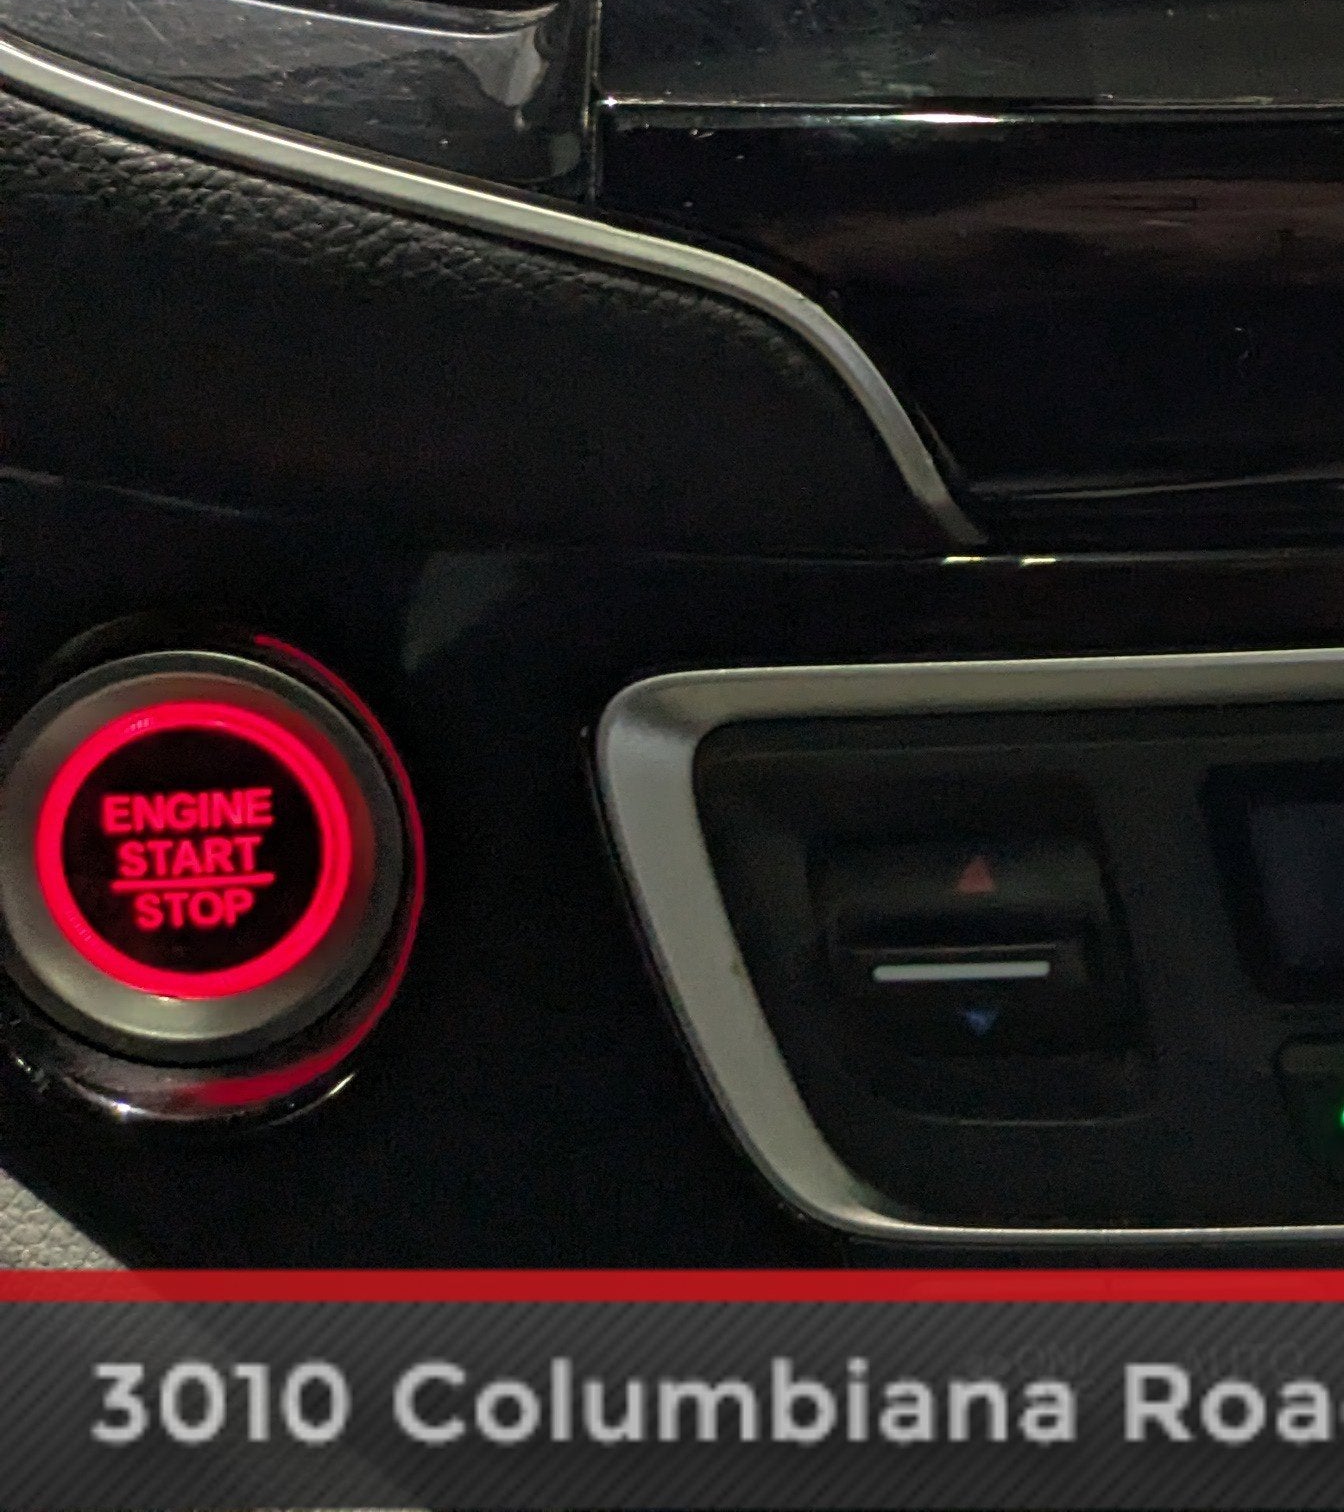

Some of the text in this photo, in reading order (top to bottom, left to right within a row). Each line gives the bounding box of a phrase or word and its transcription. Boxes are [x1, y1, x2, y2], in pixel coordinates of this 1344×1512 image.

[102, 788, 274, 834] ENGINE
[117, 836, 262, 878] START
[134, 889, 254, 930] STOP
